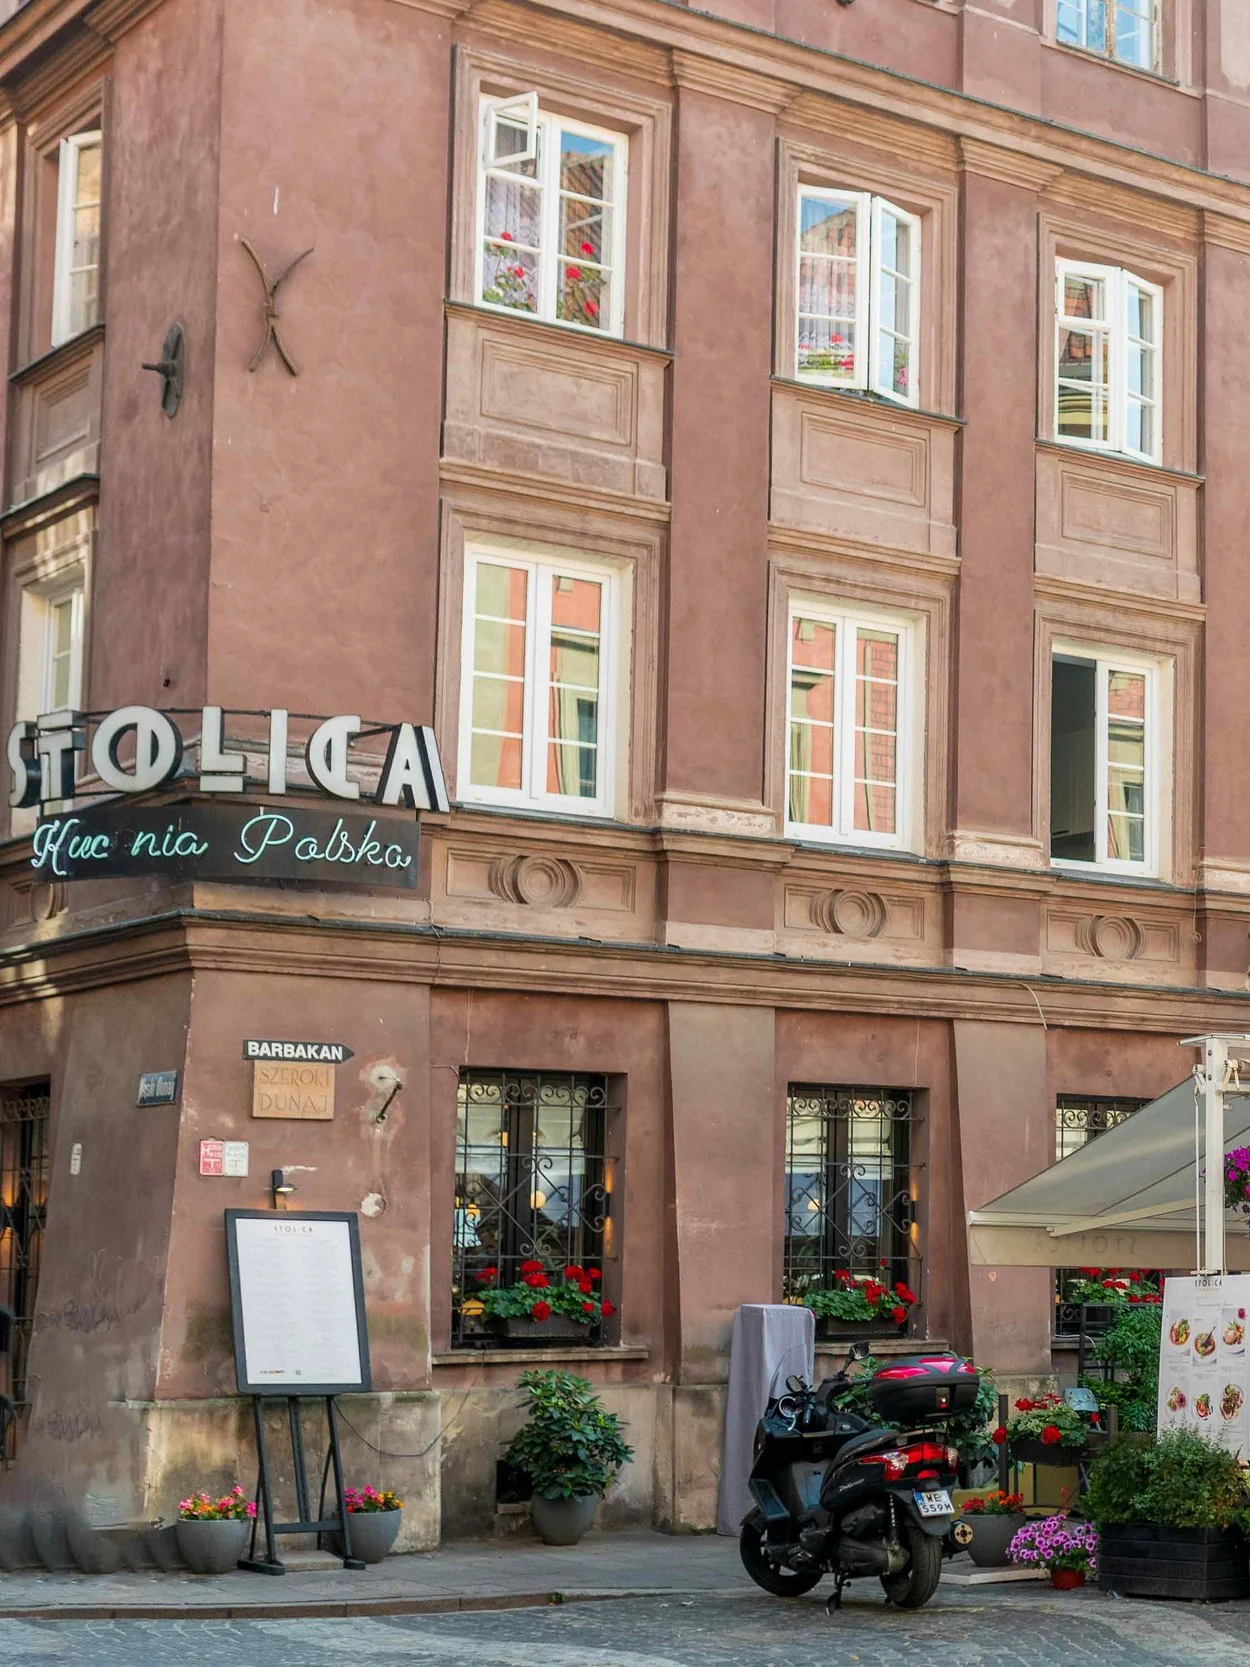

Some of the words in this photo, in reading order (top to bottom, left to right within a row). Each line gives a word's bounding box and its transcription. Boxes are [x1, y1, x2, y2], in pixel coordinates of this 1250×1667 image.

[7, 705, 450, 812] STOLICA
[31, 818, 208, 876] Kucnia
[247, 1041, 343, 1060] BARBAKAN
[260, 1067, 330, 1088] SZEROKI
[260, 1093, 328, 1115] DUNAJ
[273, 1224, 313, 1233] STOLCA
[1194, 1279, 1223, 1287] STOLCA
[925, 1493, 942, 1503] WE
